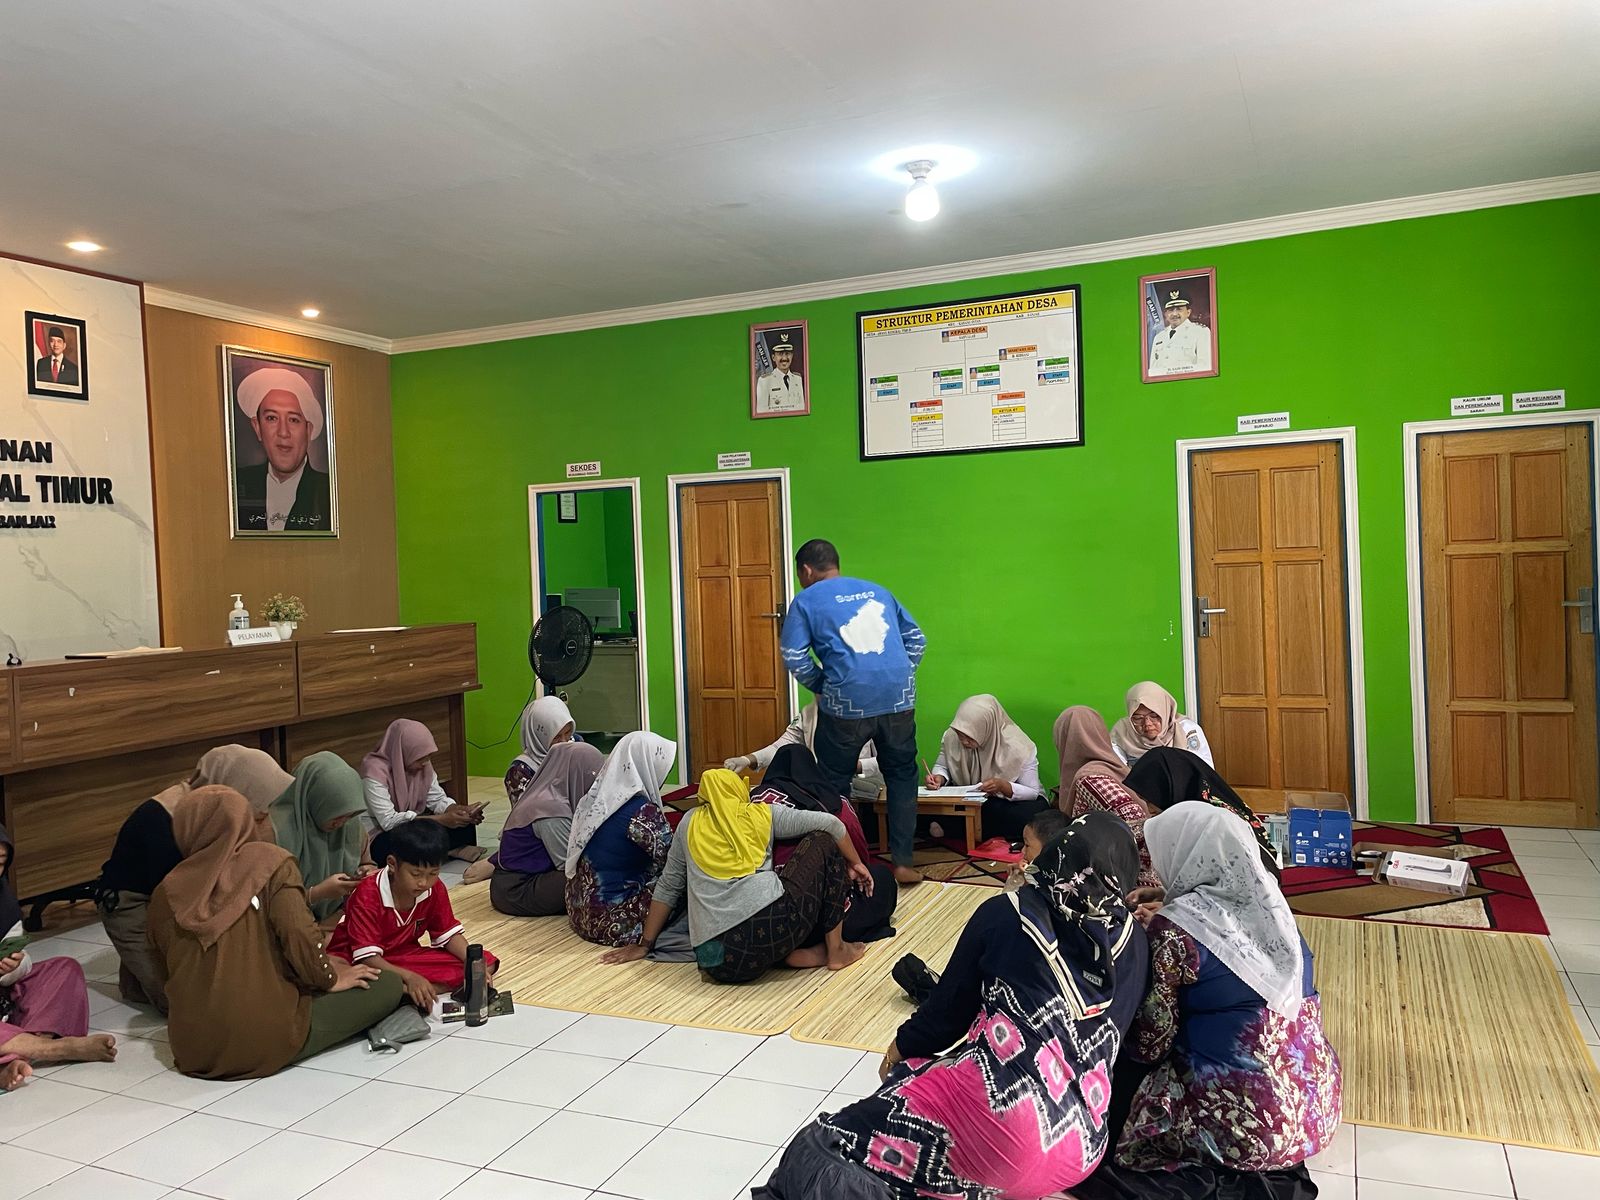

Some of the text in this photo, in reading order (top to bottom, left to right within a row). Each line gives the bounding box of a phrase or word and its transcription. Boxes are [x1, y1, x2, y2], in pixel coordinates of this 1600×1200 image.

[876, 297, 1058, 329] STRUKTUR PEMERINTAHAN DESA
[0, 439, 52, 463] NAN
[570, 463, 597, 472] SEKDES
[0, 474, 114, 504] AL TIMUR
[238, 631, 273, 641] PELAYANAN
